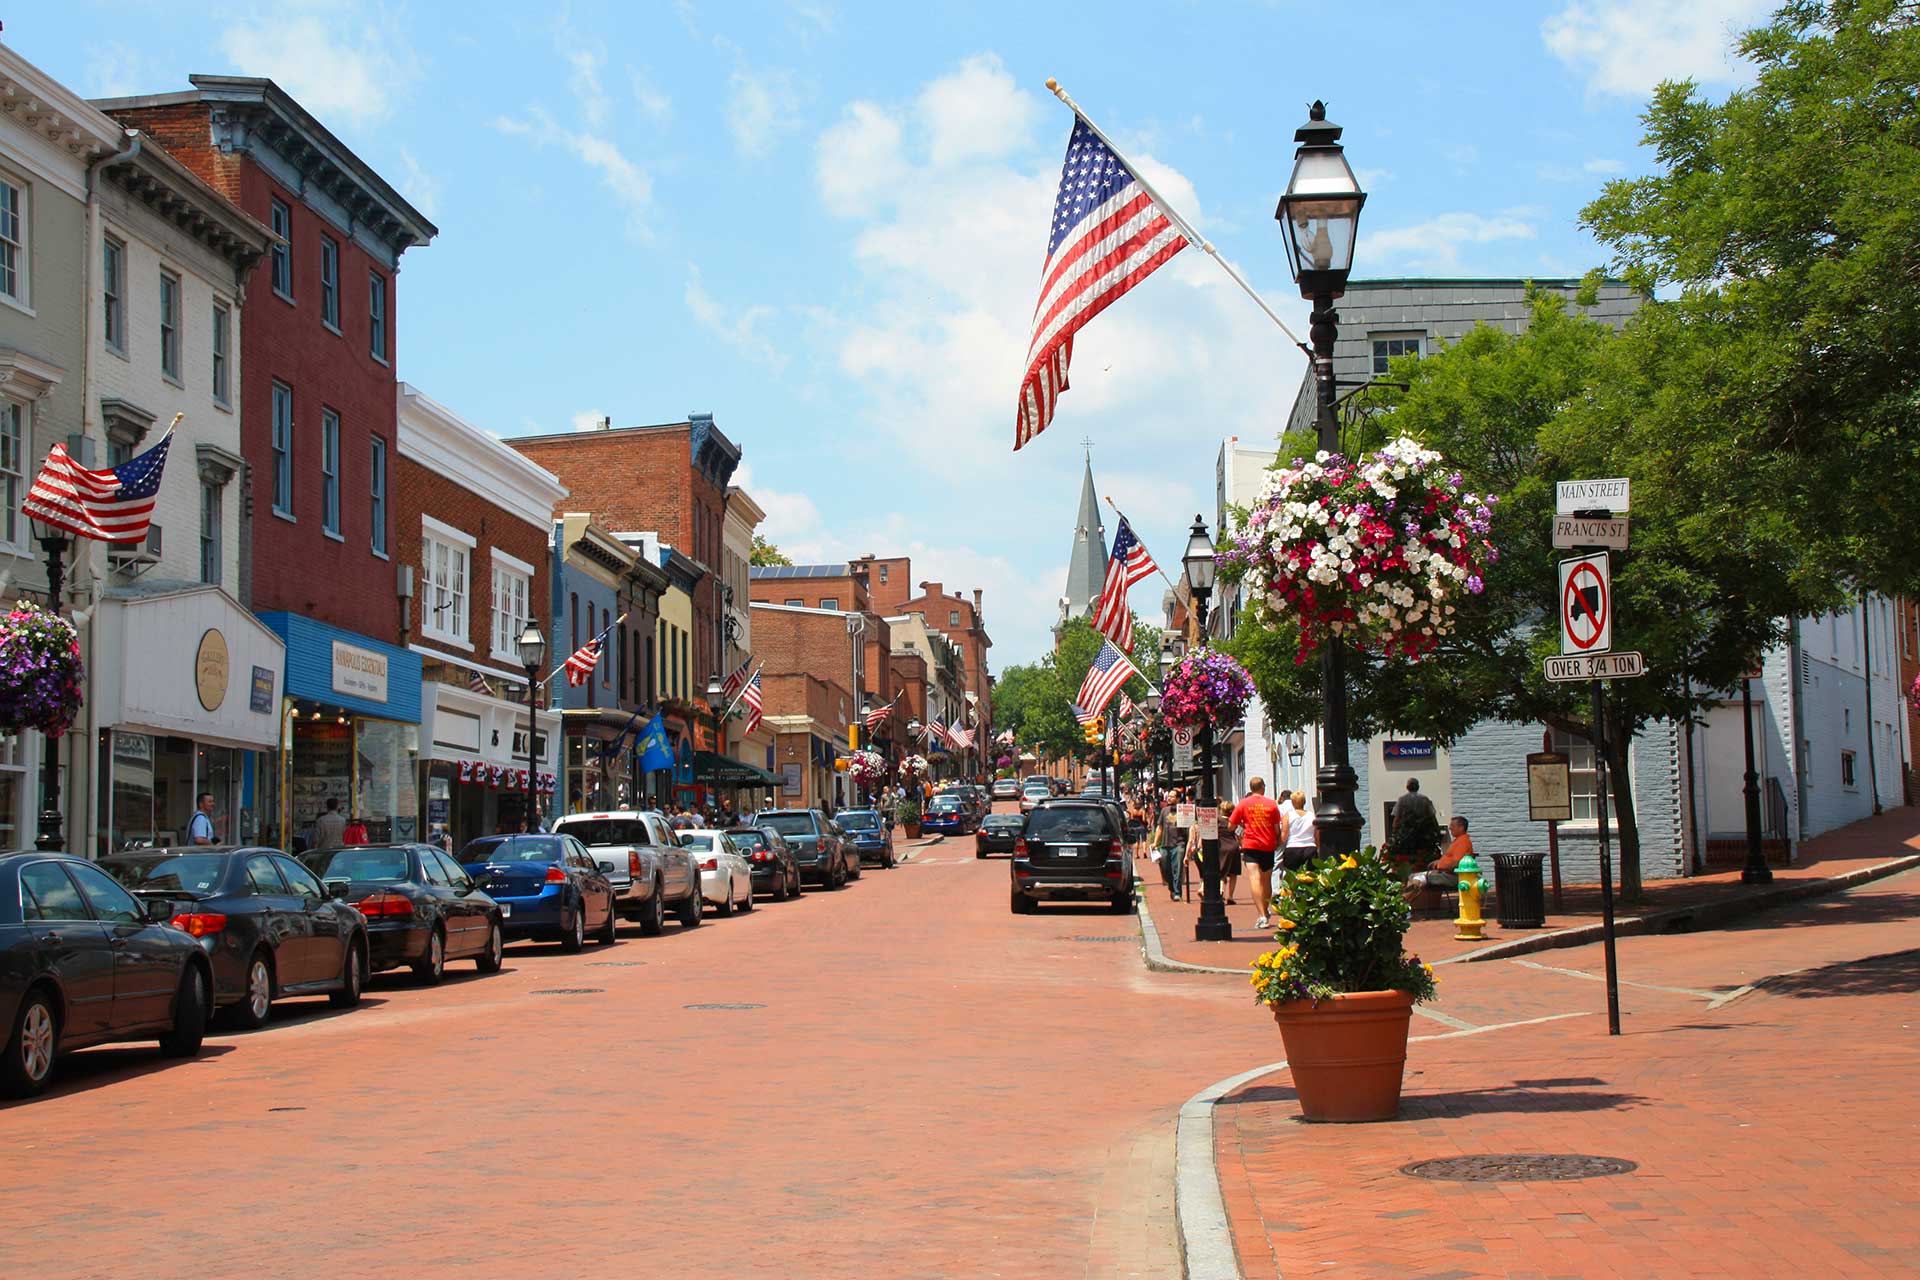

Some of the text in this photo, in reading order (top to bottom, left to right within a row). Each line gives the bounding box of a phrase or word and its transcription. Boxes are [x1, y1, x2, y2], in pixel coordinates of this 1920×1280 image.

[1560, 482, 1626, 499] MAIN STREET
[1557, 522, 1626, 537] FRANCIS ST.
[1552, 657, 1635, 676] OVER 3/4 TON
